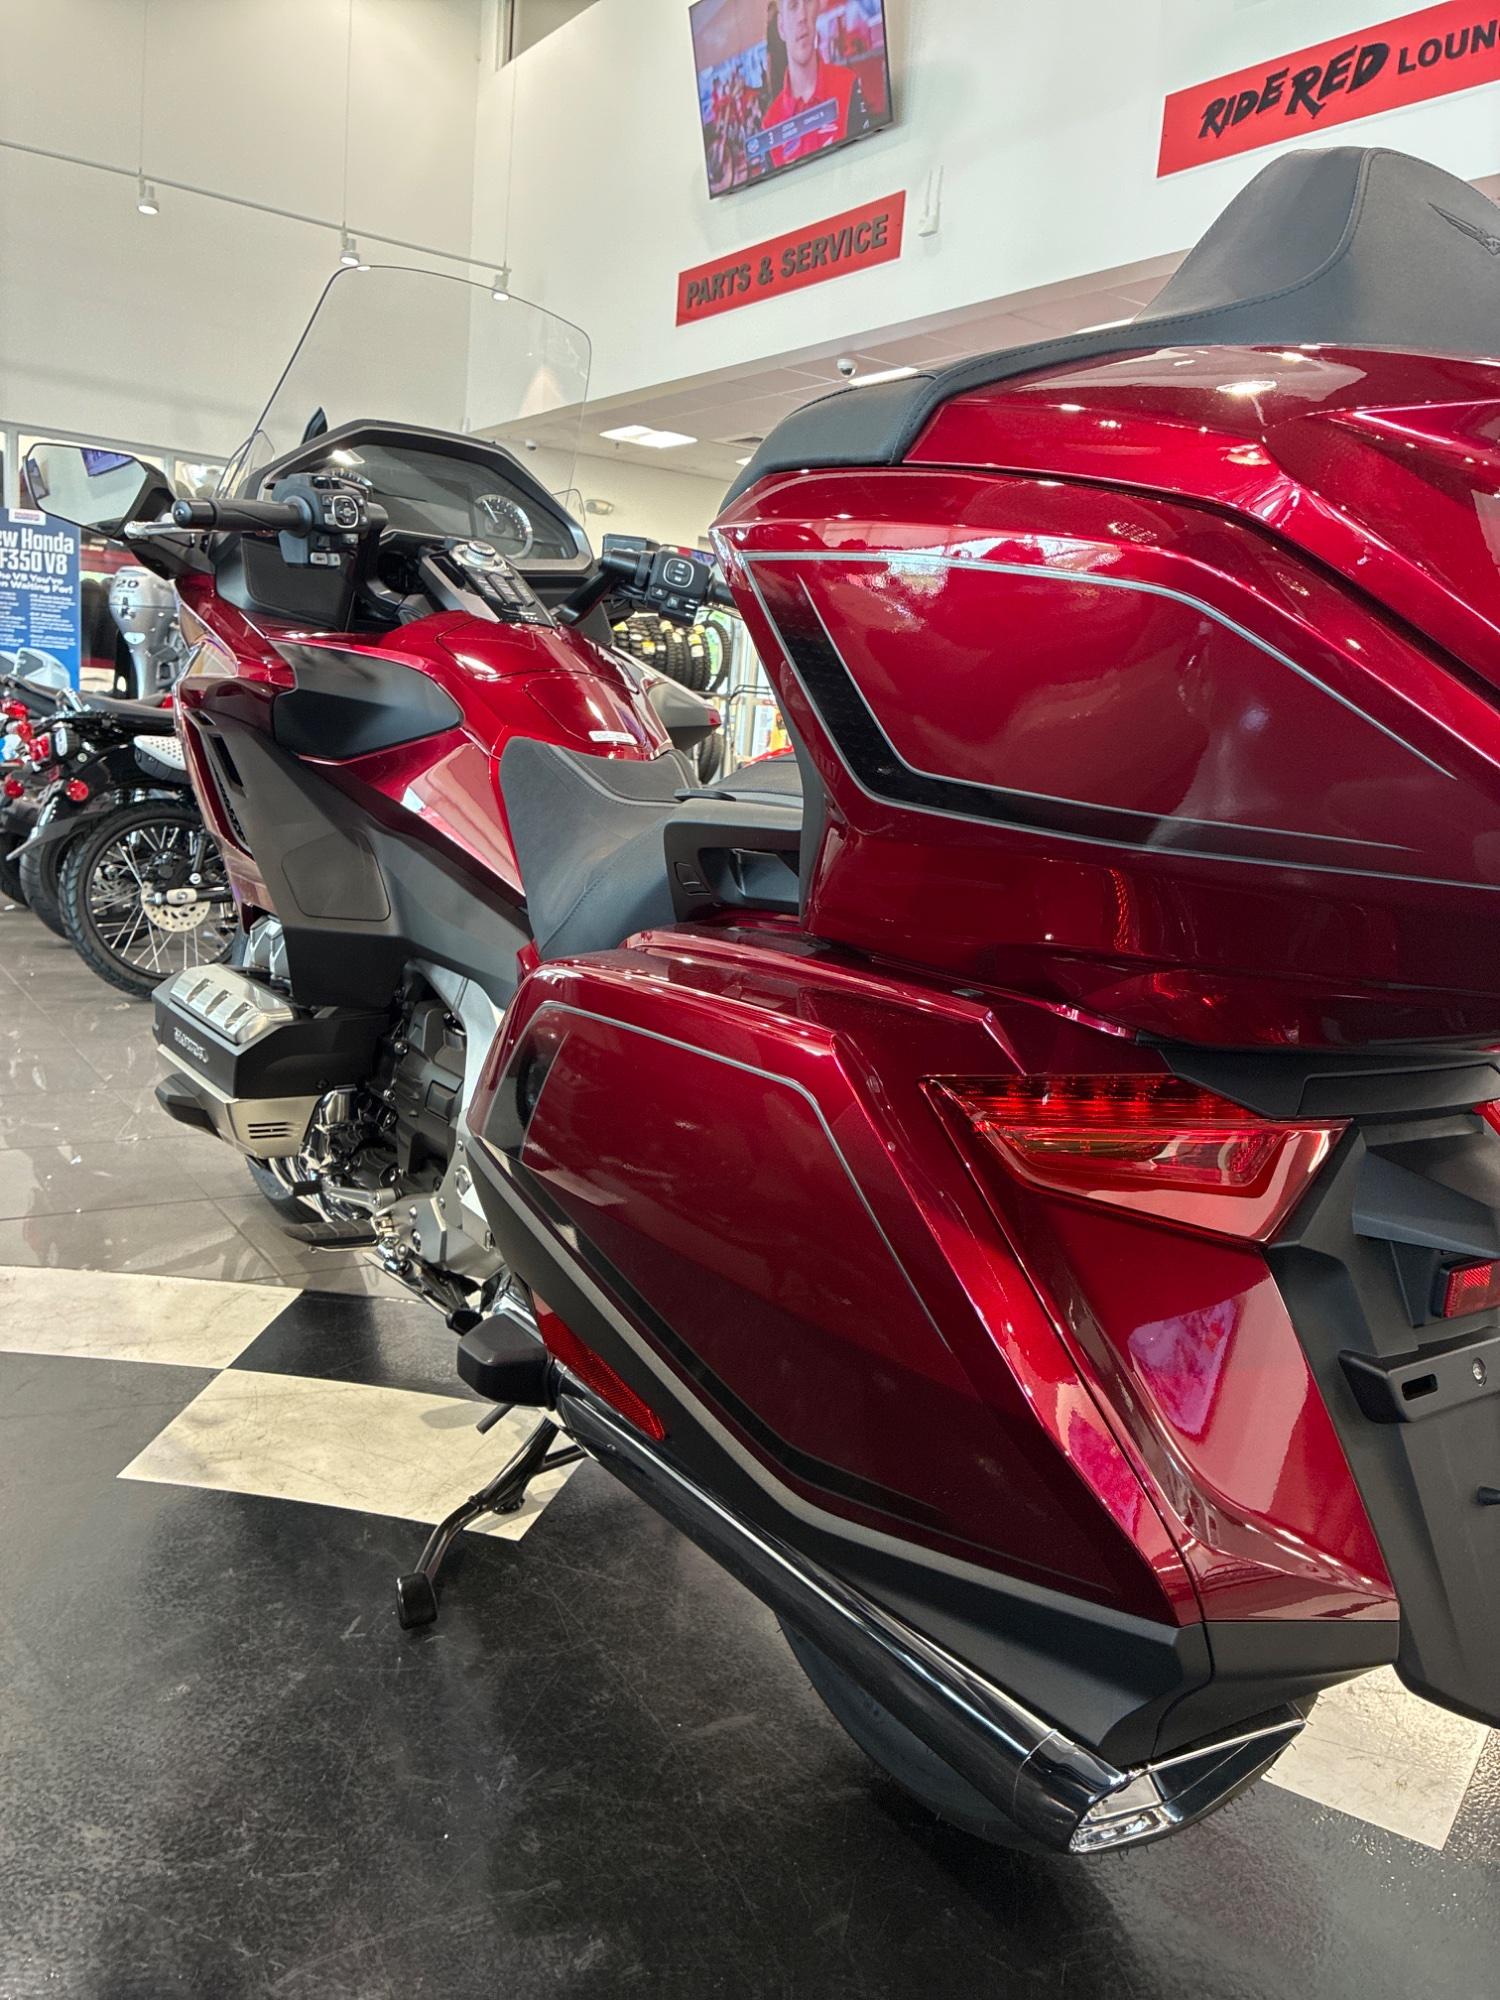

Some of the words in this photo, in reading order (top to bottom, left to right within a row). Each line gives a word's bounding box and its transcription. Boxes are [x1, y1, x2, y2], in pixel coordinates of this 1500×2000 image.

[1198, 67, 1289, 138] RIDE
[1284, 42, 1390, 119] RED
[1397, 19, 1500, 75] LOUN
[685, 264, 751, 309] PARTS
[757, 256, 774, 285] &
[780, 214, 889, 276] SERVICE
[21, 527, 75, 555] Honda
[43, 552, 68, 575] V8
[10, 580, 50, 594] Waiting
[116, 579, 139, 588] 20
